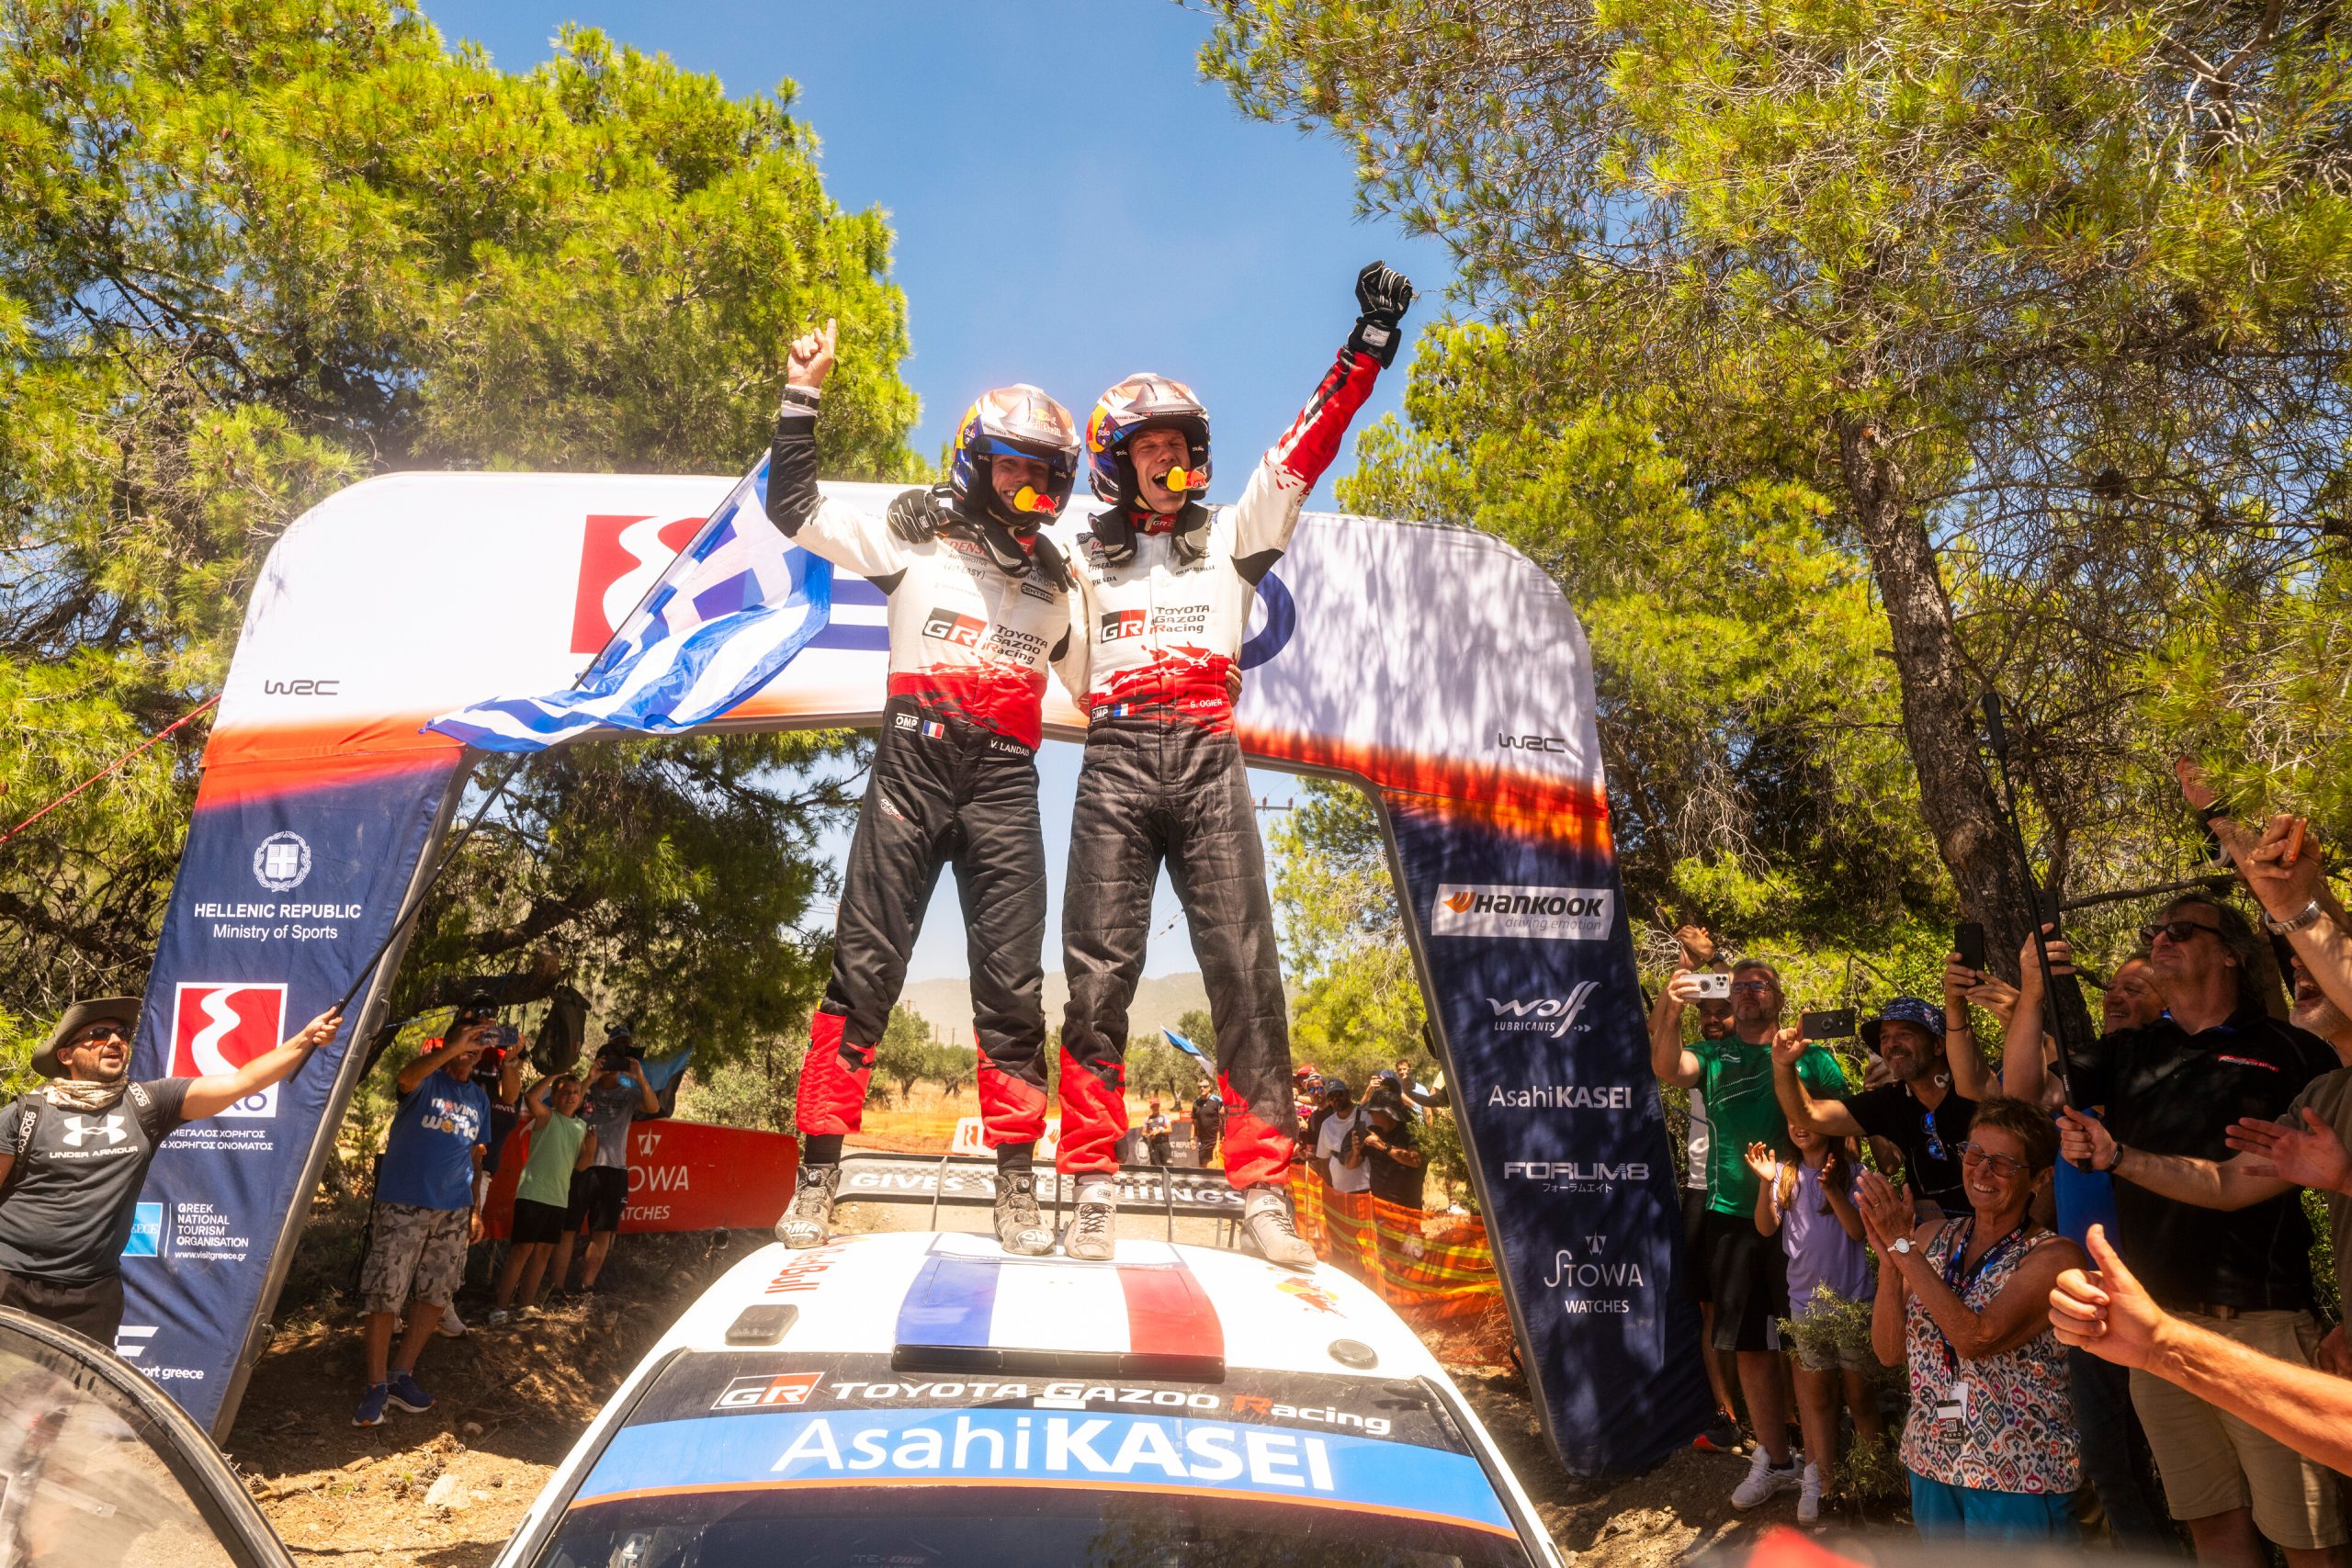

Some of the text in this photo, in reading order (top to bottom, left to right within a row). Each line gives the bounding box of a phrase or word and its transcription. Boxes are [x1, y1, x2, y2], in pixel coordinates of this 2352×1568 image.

[949, 541, 984, 555] DENS
[1092, 576, 1117, 586] PRADA
[1155, 605, 1210, 616] TOYOTA
[1154, 615, 1205, 625] GAZOO
[923, 619, 979, 647] GR
[1102, 620, 1144, 641] GR
[1151, 624, 1204, 635] Racing
[996, 625, 1048, 649] TOYOTA
[989, 634, 1041, 655] GAZOO
[982, 643, 1035, 665] Racing
[264, 680, 340, 696] WRC
[1190, 699, 1223, 709] S. OGIER
[1091, 707, 1110, 720] OMP
[895, 715, 918, 729] OMP
[990, 739, 1030, 757] V. LANDAIS
[1498, 732, 1566, 753] WRC
[194, 903, 362, 919] HELLENIC REPUBLIC
[1505, 918, 1601, 931] driving emotion
[212, 923, 338, 942] Ministry of Sports
[1494, 1021, 1555, 1032] LUBRICANTS
[431, 1097, 480, 1122] moving
[444, 1109, 468, 1122] your
[169, 1128, 266, 1139] ΜΕΓΑΛΟΣ ΧΟΡΗΓΟΣ
[421, 1114, 481, 1142] world
[50, 1145, 139, 1159] UNDER ARMOUR
[159, 1140, 274, 1151] & ΧΟΡΗΓΟΣ ΟΝΟΜΑΤΟΣ
[627, 1165, 690, 1192] OWA
[1503, 1161, 1650, 1182] FORUM8
[849, 1172, 967, 1191] GIVES
[1542, 1182, 1613, 1194] フォーラムエイト
[177, 1203, 214, 1213] GREEK
[618, 1204, 671, 1221] ATCHES
[177, 1213, 231, 1225] NATIONAL
[130, 1223, 159, 1235] EECE
[177, 1225, 225, 1235] TOURISM
[175, 1235, 249, 1247] ORGANISATION
[175, 1250, 247, 1262] www.visitgreece.gr
[1544, 1249, 1644, 1288] STOWA
[1565, 1300, 1630, 1314] WATCHES
[161, 1368, 204, 1381] greece
[718, 1382, 1392, 1437] GR TOYOTA GAZOO Racing
[770, 1415, 1336, 1493] AsahiKASEI
